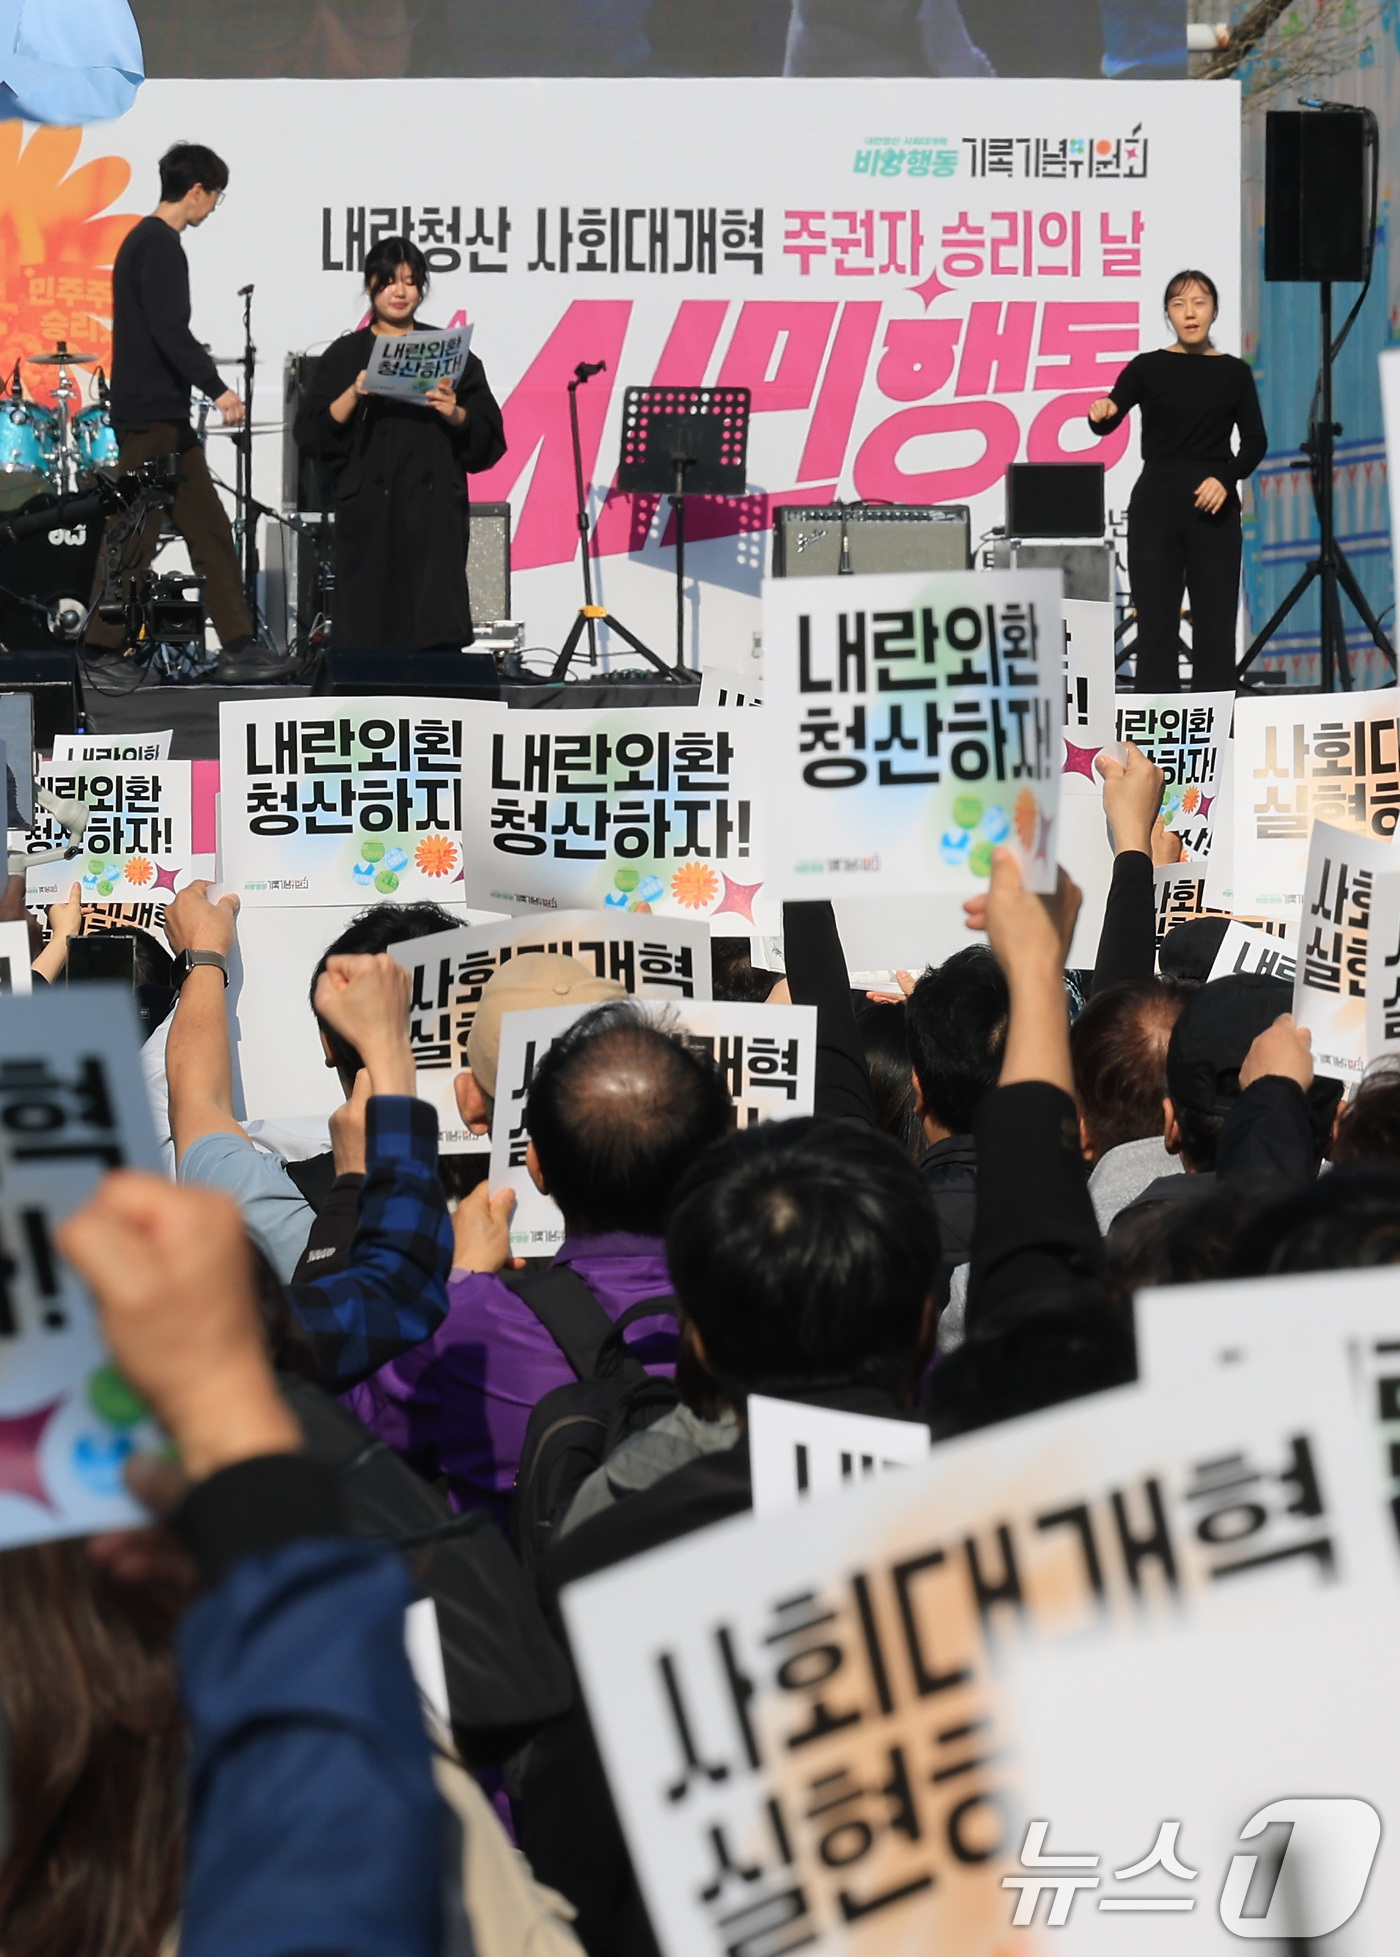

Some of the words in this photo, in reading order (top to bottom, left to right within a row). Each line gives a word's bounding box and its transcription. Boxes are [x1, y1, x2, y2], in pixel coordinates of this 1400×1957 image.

[853, 147, 959, 178] 비상행동
[962, 121, 1148, 178] 기록기념위원회
[527, 207, 764, 275] 사회대개혁
[783, 209, 924, 276] 주권자
[941, 210, 1081, 277] 승리의
[1100, 210, 1145, 277] 날
[798, 602, 1039, 694] 내란외환
[246, 718, 463, 775] 내란외환
[798, 698, 1051, 789] 청산하자!
[1115, 707, 1214, 746] 란외환
[491, 731, 735, 793] 내란외환
[490, 798, 751, 860] 청산하자!
